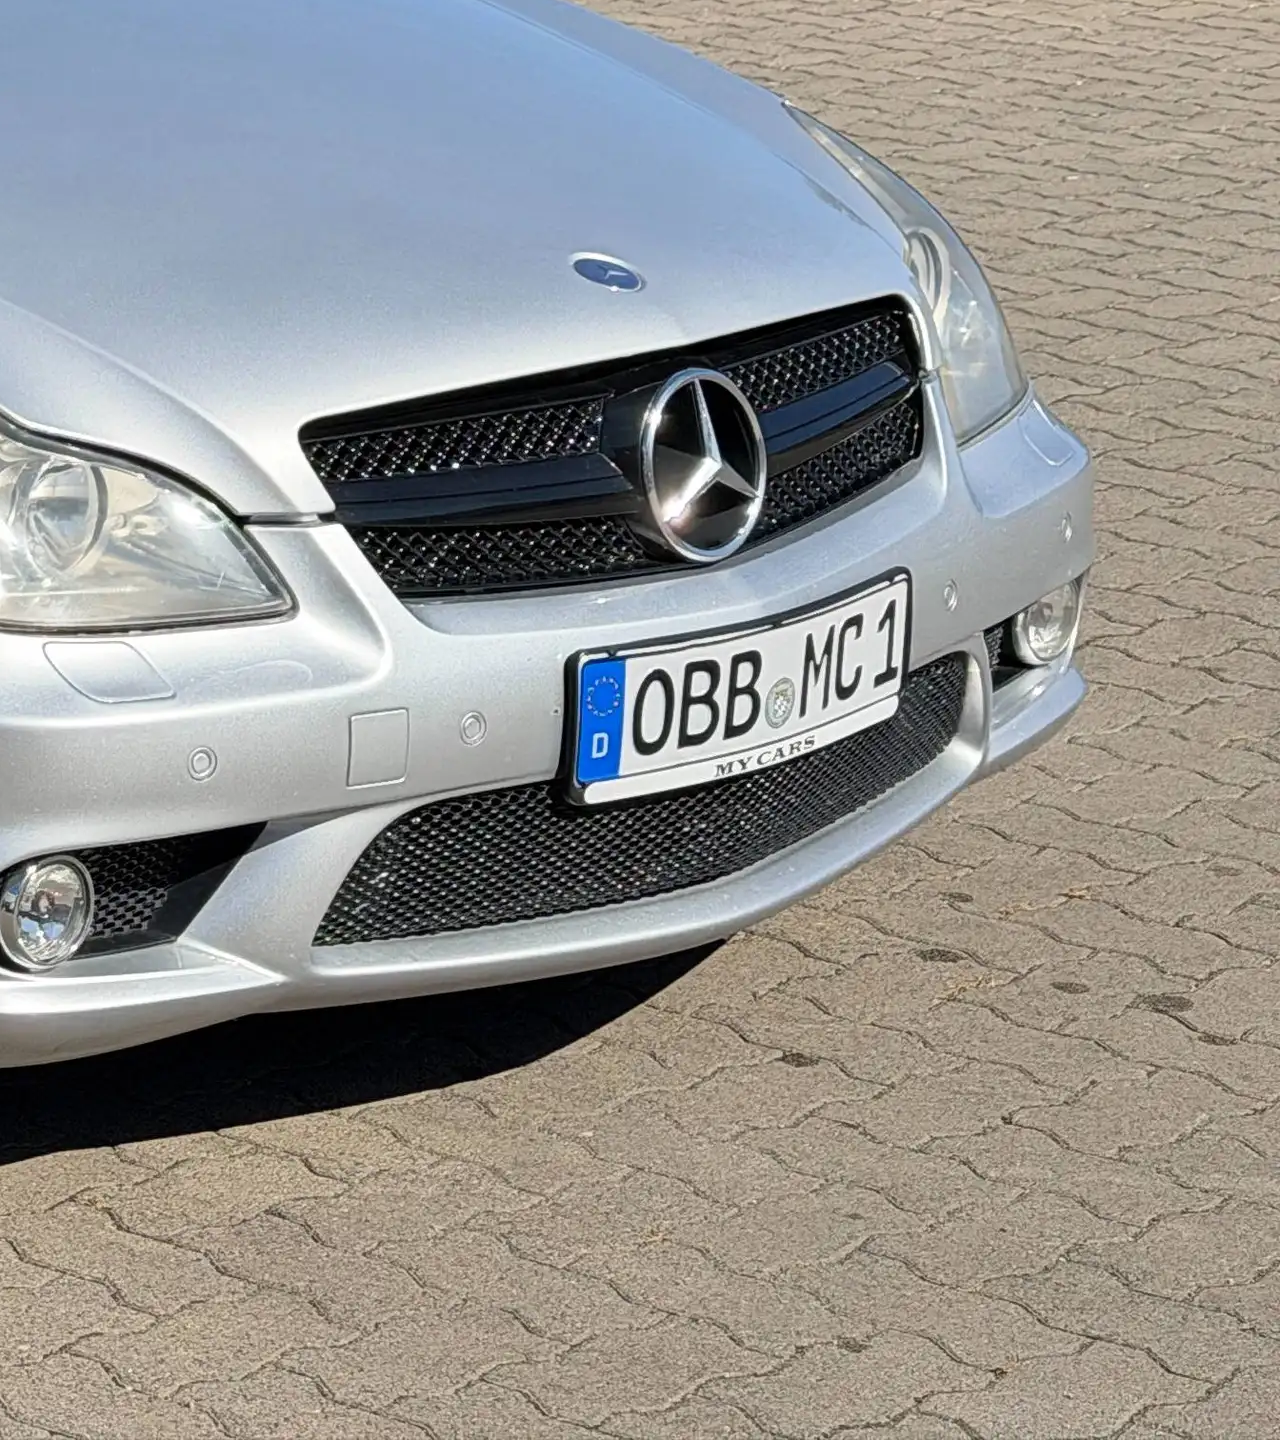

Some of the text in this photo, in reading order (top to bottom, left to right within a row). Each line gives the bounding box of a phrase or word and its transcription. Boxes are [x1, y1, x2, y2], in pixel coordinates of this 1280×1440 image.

[632, 599, 898, 756] OBB MC 1
[591, 731, 609, 759] D
[714, 735, 816, 778] MY CARS
